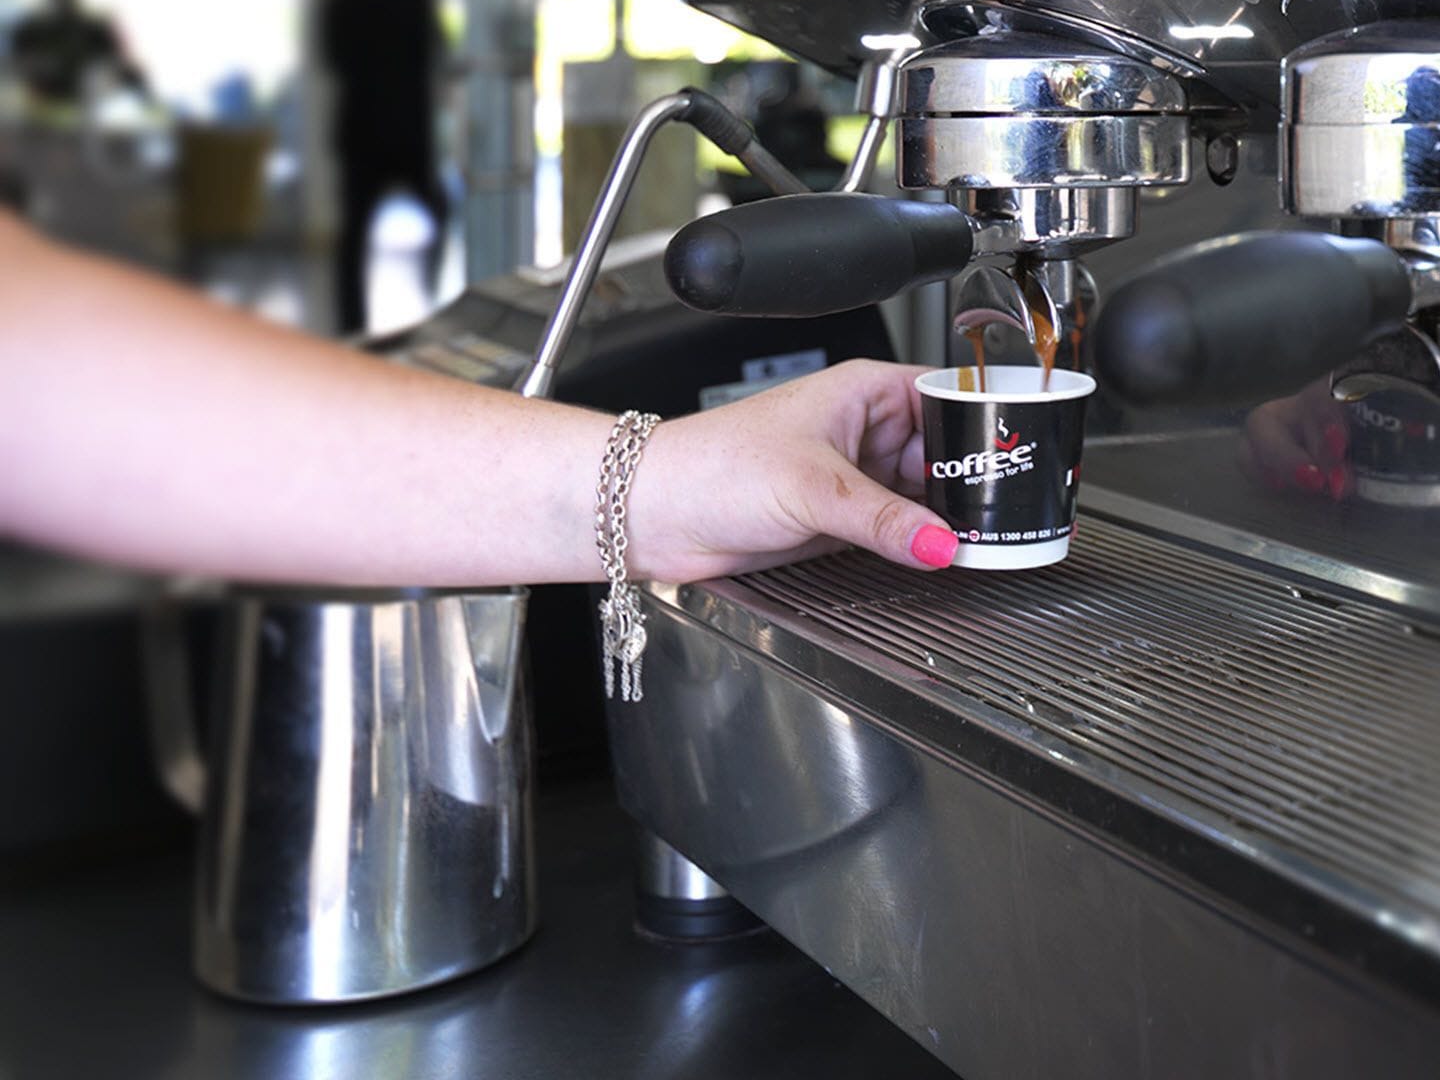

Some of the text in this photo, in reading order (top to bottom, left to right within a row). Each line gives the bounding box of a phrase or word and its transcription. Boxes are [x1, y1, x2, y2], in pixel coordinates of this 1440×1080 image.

[931, 444, 1032, 479] coffee
[1005, 467, 1019, 477] for
[1020, 462, 1034, 472] life
[981, 532, 999, 541] AUS
